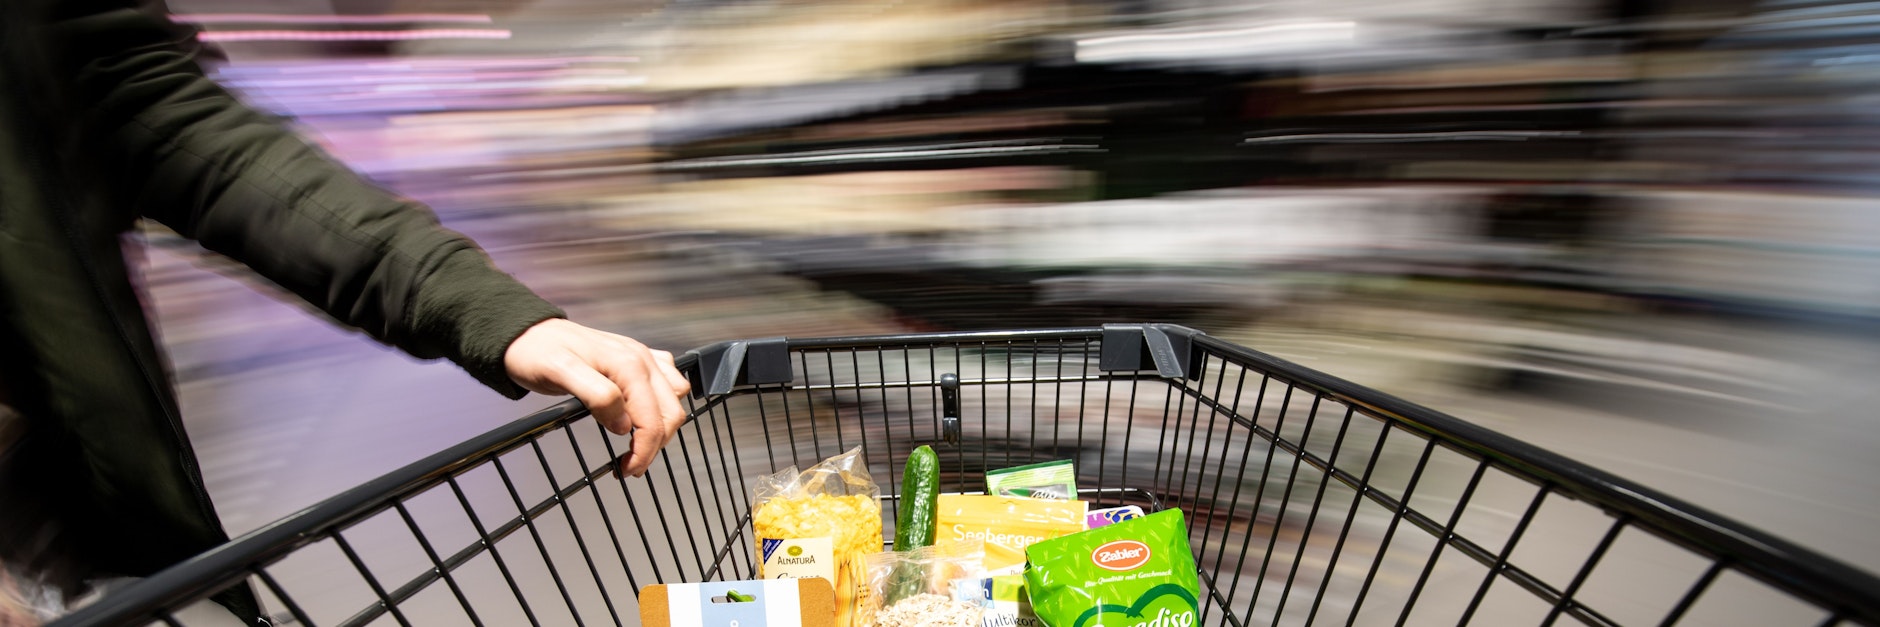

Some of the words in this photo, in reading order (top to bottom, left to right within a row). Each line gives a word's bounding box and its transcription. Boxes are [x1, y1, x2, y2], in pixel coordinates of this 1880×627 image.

[777, 555, 815, 565] ALNATURA
[1099, 547, 1143, 563] Zabler
[1138, 569, 1172, 579] Geschmack
